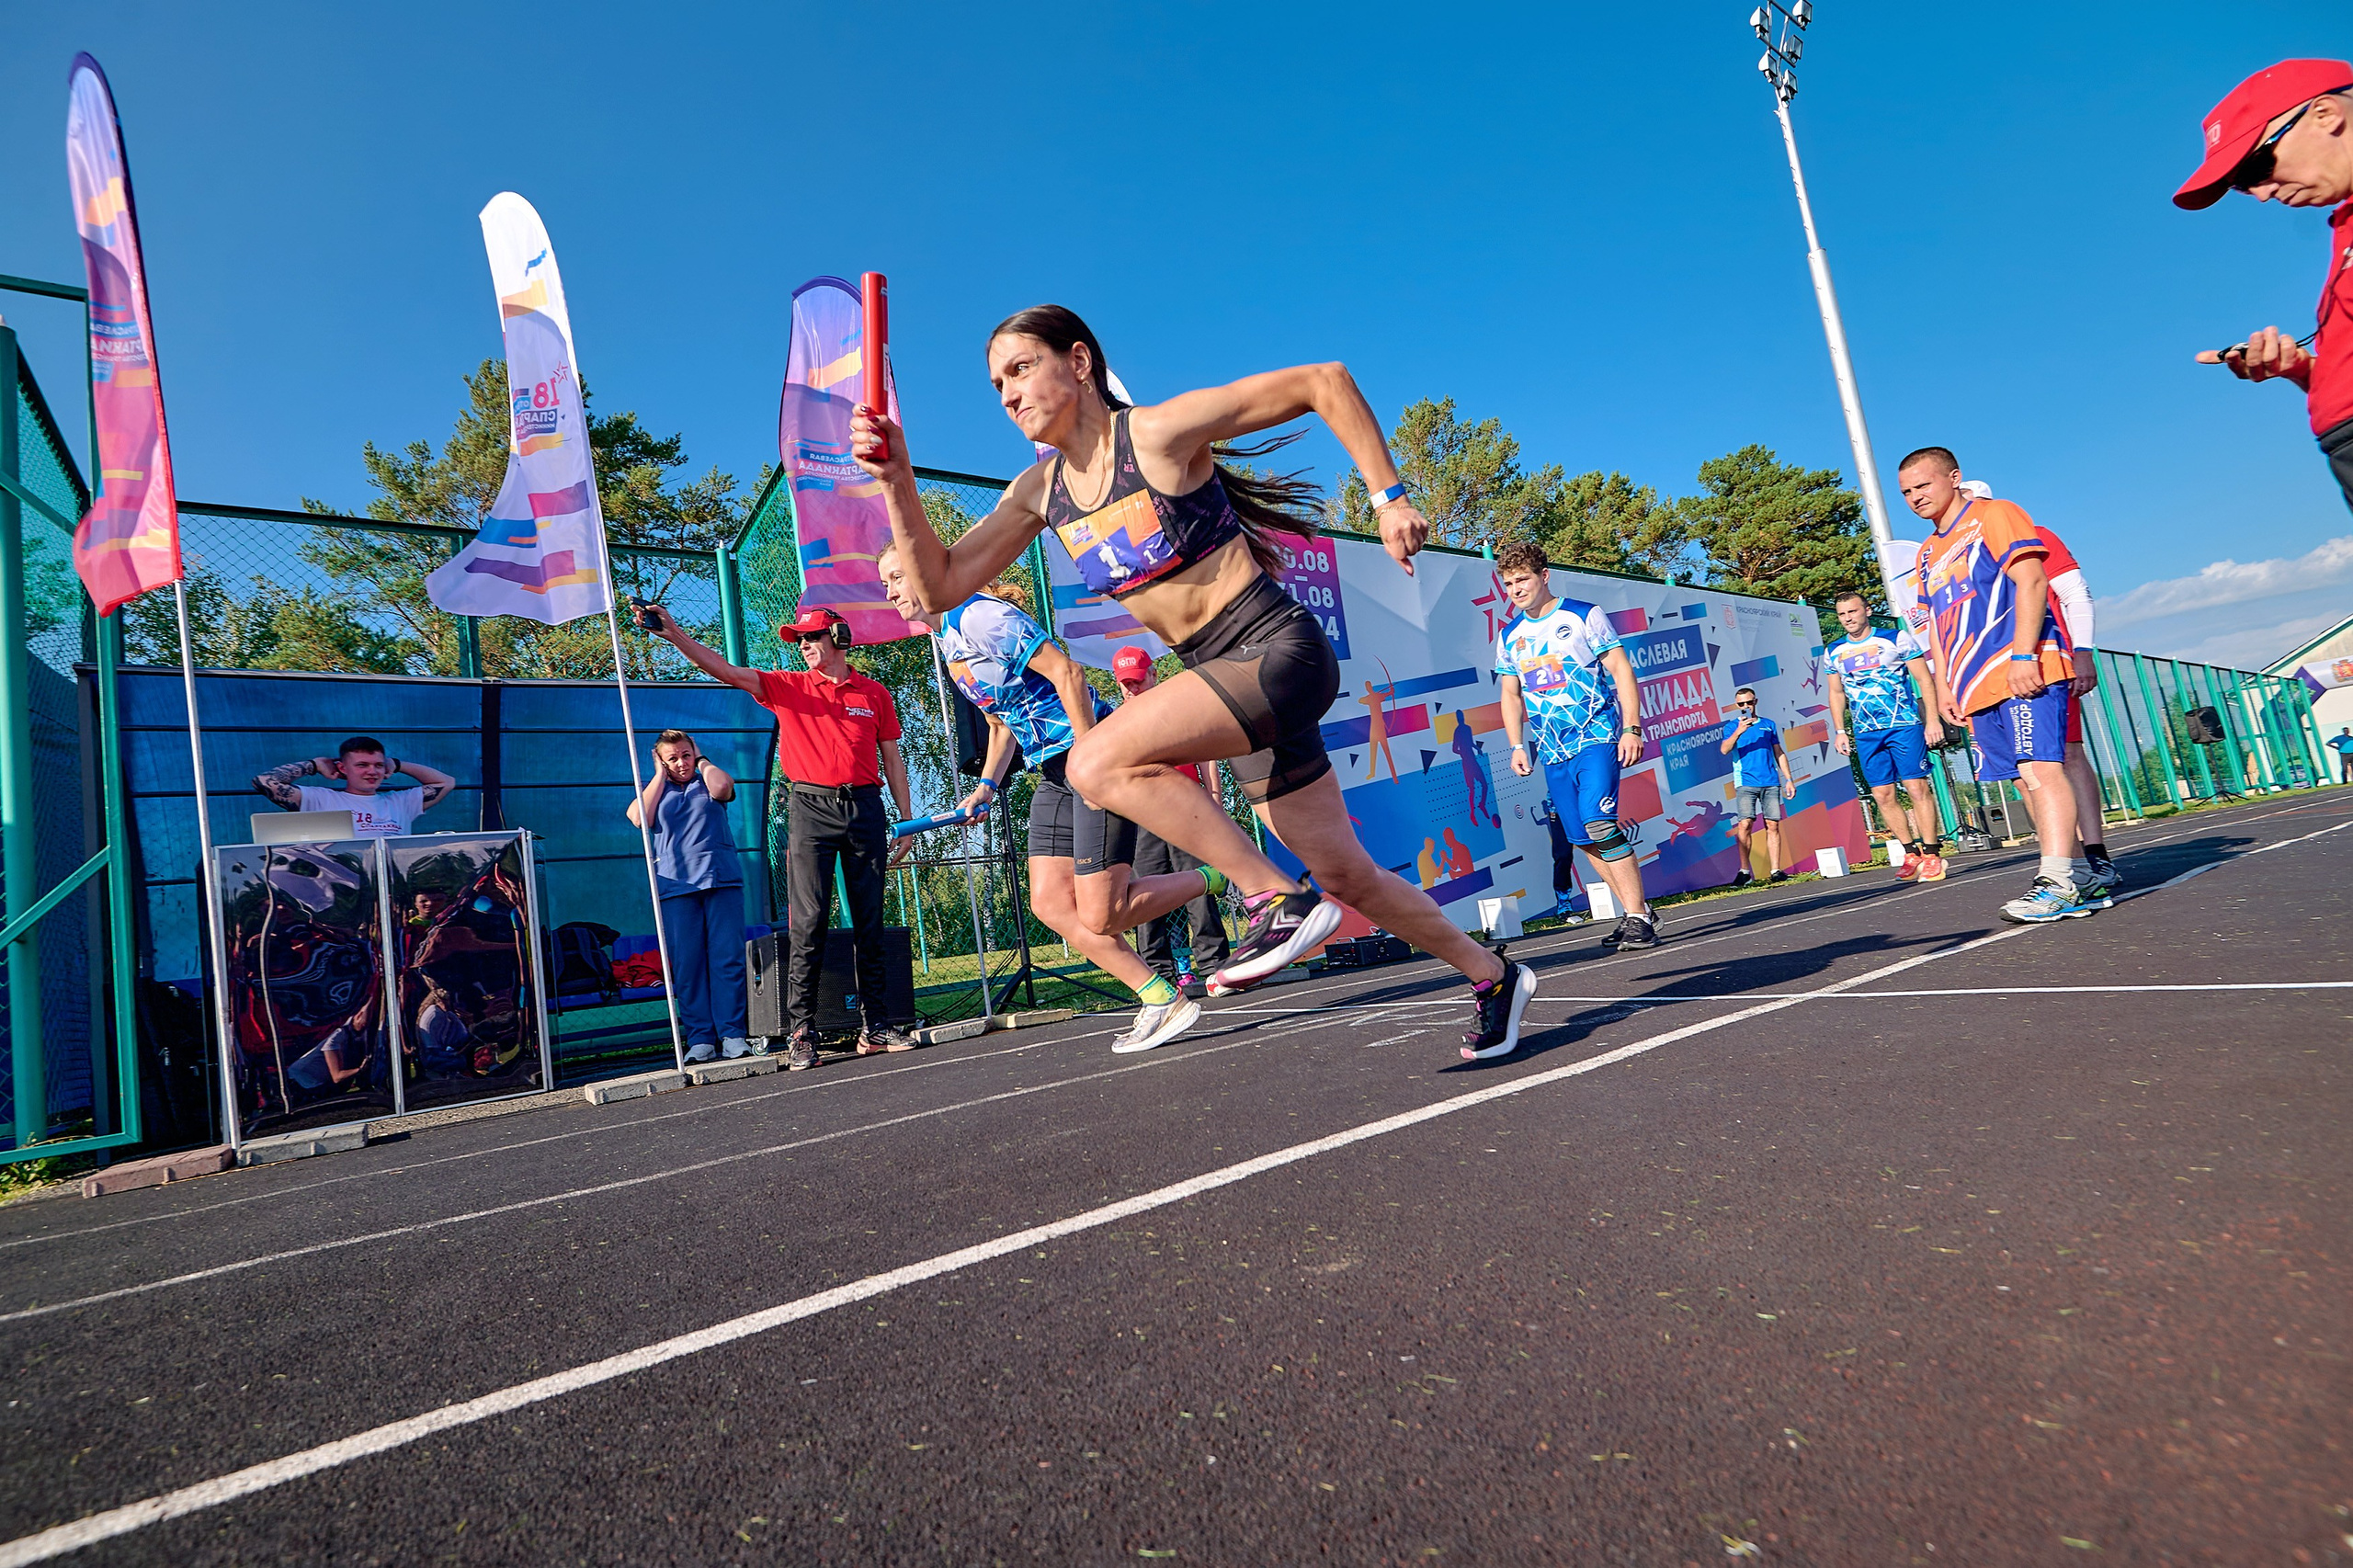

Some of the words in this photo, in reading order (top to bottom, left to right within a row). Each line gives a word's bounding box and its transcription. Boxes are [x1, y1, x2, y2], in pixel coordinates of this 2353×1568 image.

[1098, 545, 1131, 579] 1
[1142, 549, 1158, 565] 1
[1277, 583, 1336, 608] 1.08
[1945, 585, 1953, 604] 1
[1960, 584, 1969, 593] 3
[1905, 607, 1917, 620] 18
[1854, 655, 1866, 667] 2
[1536, 669, 1549, 686] 2
[1553, 674, 1562, 682] 3
[1648, 710, 1709, 739] ТРАНСПОРТА
[2019, 703, 2035, 756] АВТОДОР
[1665, 727, 1725, 756] КРАСНОЯРСКОГ
[1669, 755, 1689, 771] КРАЯ
[357, 812, 372, 824] 18
